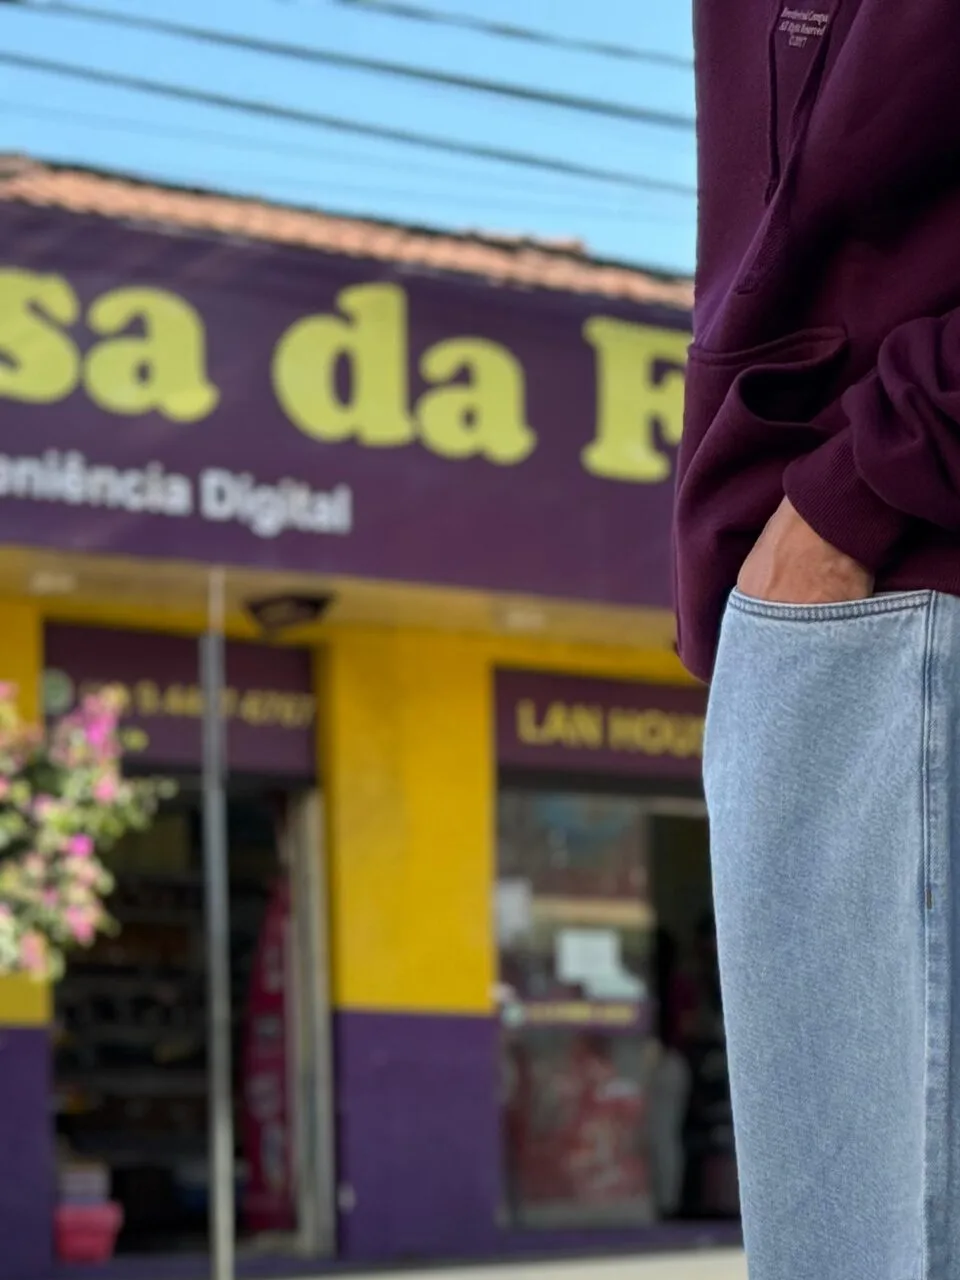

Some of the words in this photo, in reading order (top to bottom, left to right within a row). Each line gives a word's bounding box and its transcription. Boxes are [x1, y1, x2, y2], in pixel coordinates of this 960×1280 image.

[273, 281, 535, 465] da
[199, 467, 353, 538] Digital
[515, 699, 604, 749] LAN
[607, 707, 706, 759] HOU
